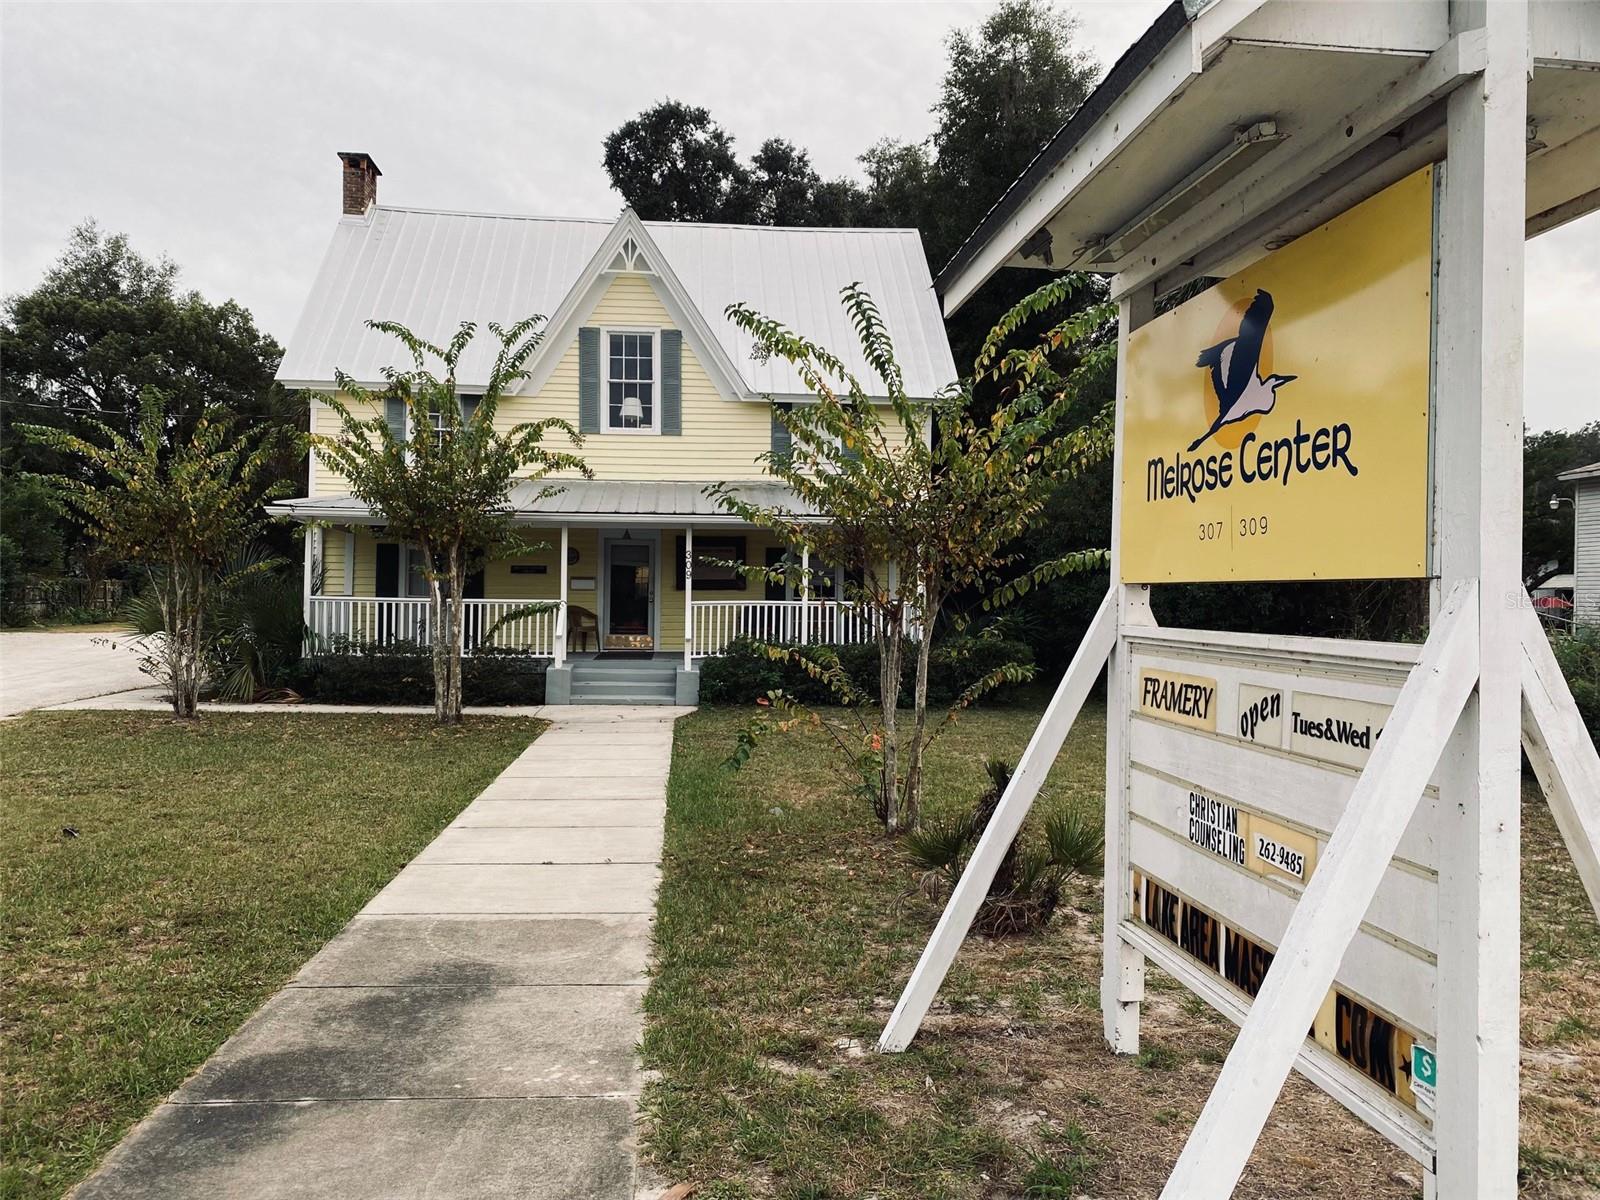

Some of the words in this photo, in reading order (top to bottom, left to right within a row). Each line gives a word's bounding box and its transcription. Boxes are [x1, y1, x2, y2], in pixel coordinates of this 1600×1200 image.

[1147, 451, 1233, 503] Melrose
[1239, 419, 1359, 486] Center
[1198, 521, 1224, 541] 307
[1239, 516, 1268, 537] 309
[1142, 677, 1214, 719] FRAMERY
[1240, 692, 1281, 739] open
[1291, 711, 1371, 750] Tues&Wed
[1189, 791, 1238, 835] CHRISTIAN
[1188, 817, 1245, 865] COUNSELING
[1258, 838, 1303, 875] 262-9485
[1145, 878, 1179, 947] LAKE
[1180, 901, 1221, 974] AREA
[1224, 924, 1275, 998] MAS
